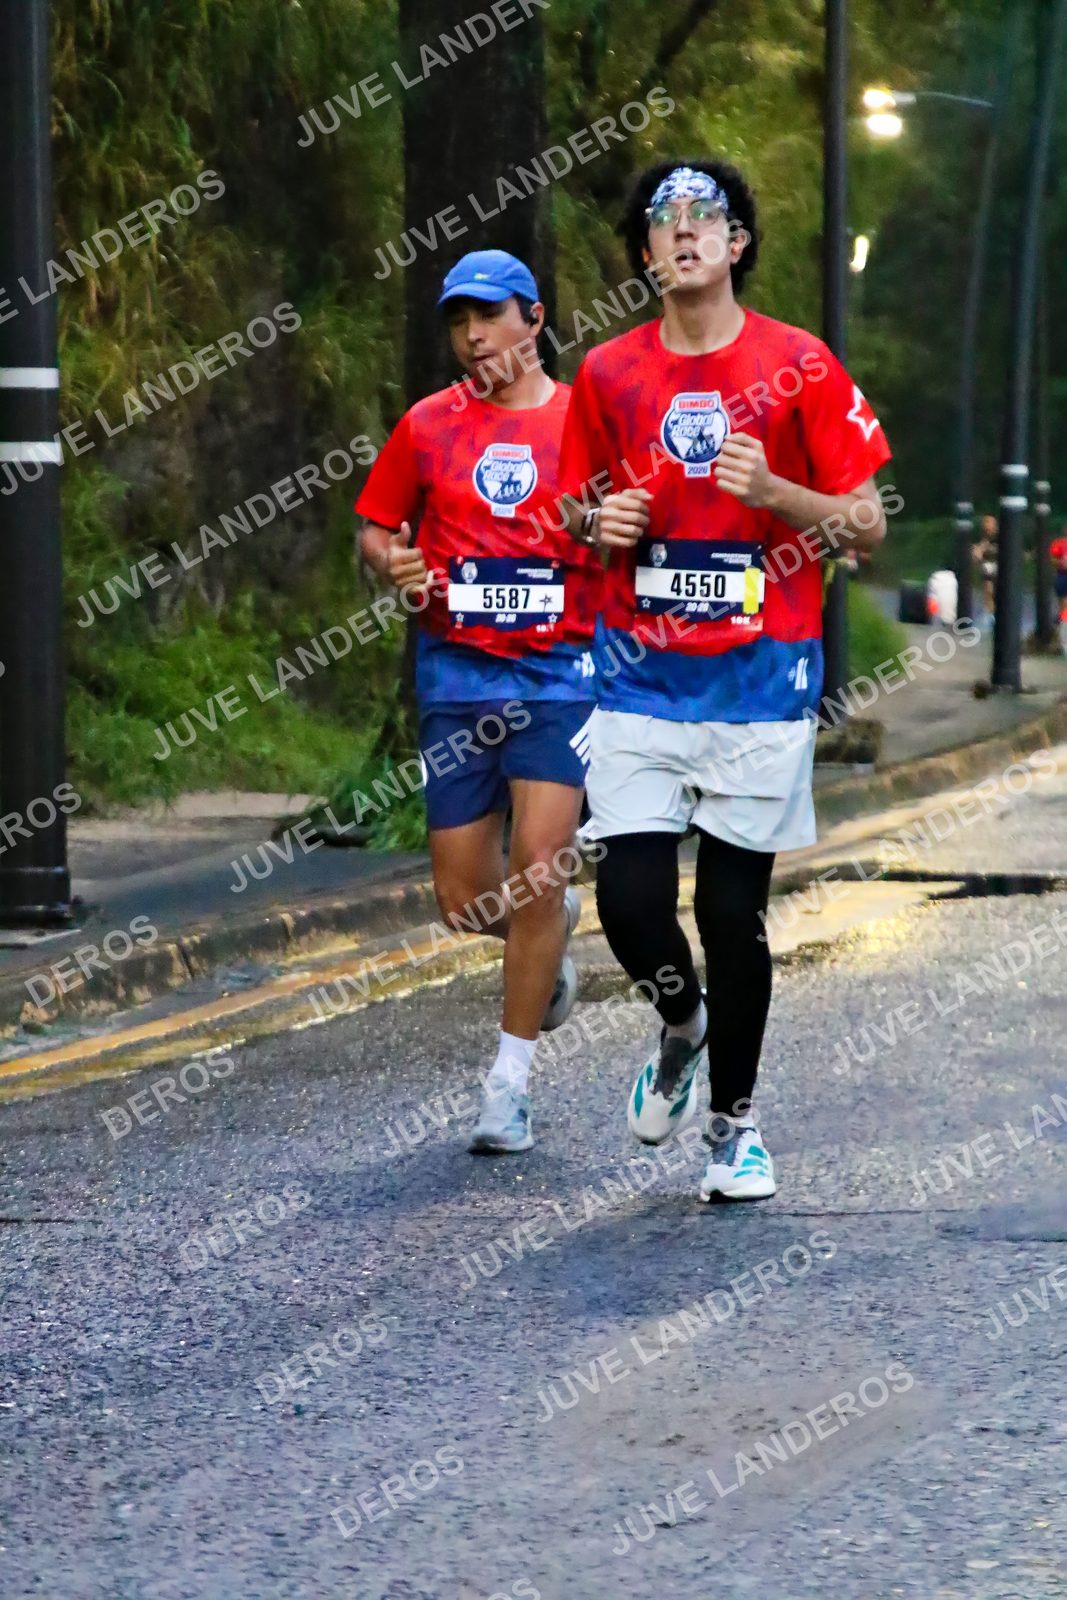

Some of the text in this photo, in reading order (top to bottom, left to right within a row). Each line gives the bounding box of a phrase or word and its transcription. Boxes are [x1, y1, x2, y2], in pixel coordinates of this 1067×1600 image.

[679, 400, 714, 409] BIMBO
[678, 413, 714, 426] Global
[671, 425, 700, 437] Race
[491, 461, 523, 473] Global
[687, 466, 708, 475] 2026
[484, 471, 509, 481] Race
[670, 572, 726, 598] 4550
[482, 587, 530, 609] 5587
